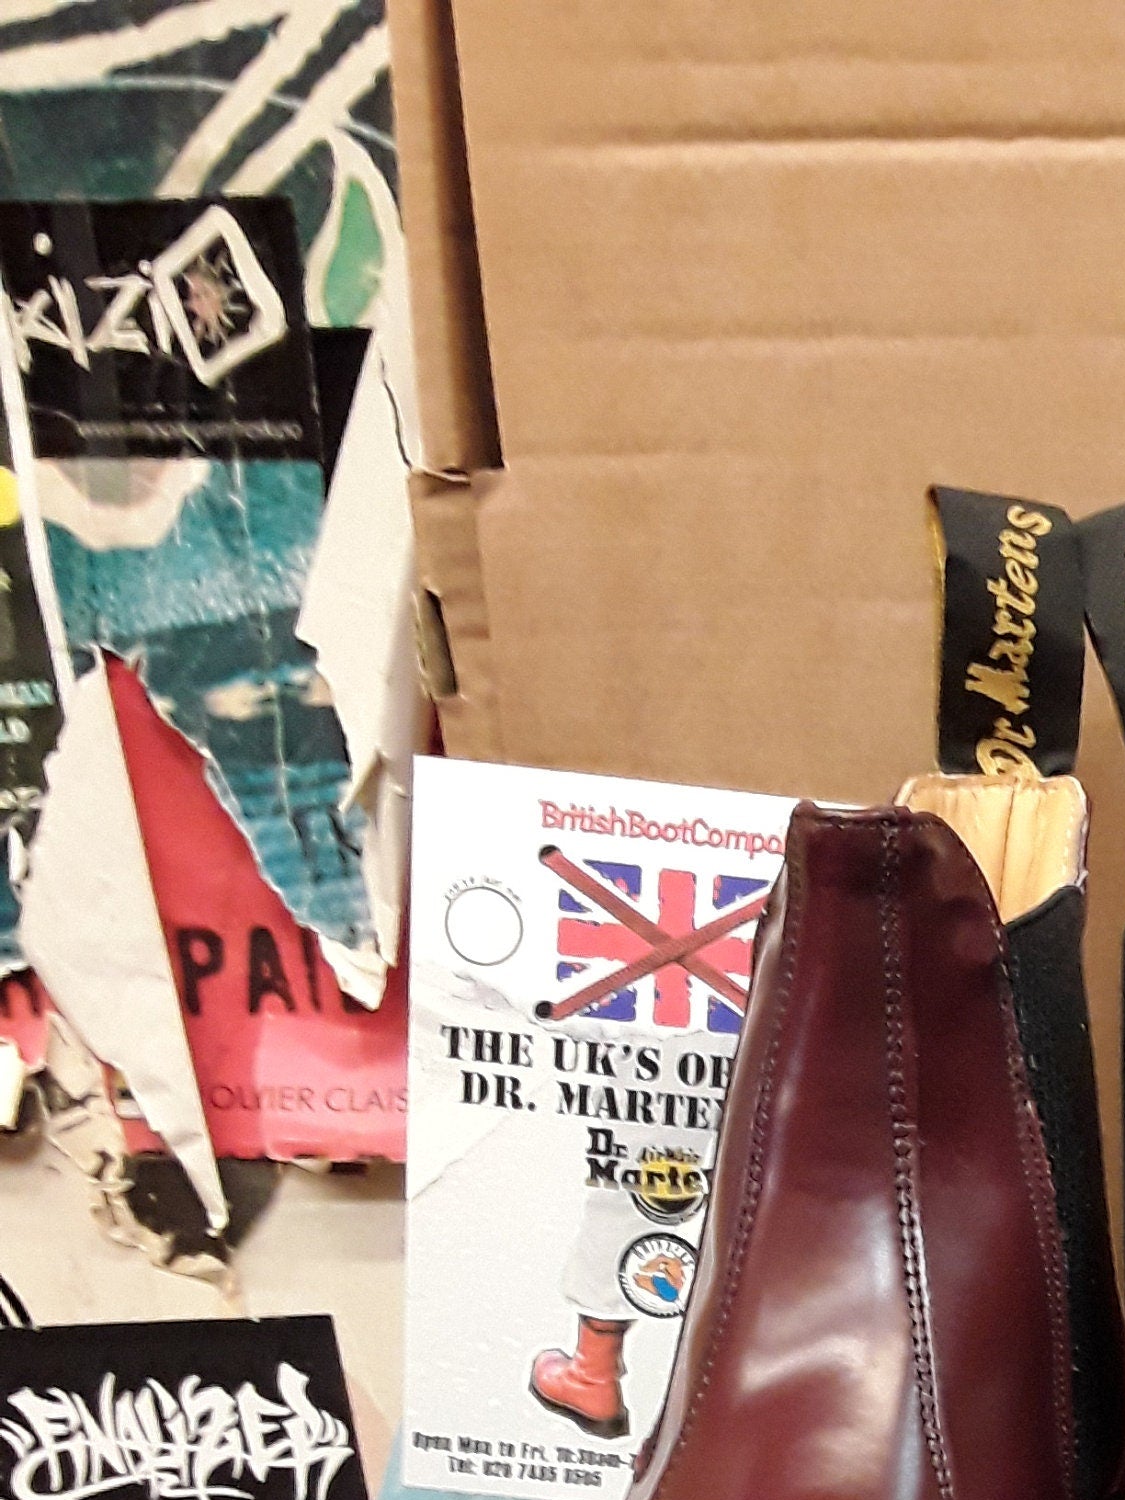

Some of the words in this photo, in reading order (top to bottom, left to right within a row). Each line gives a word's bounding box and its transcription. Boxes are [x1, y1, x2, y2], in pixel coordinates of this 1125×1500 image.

[964, 505, 1053, 715] Martens
[440, 1024, 534, 1068] THE
[552, 1035, 662, 1082] UK'S
[459, 1069, 537, 1112] DR.
[585, 1157, 709, 1195] Marte
